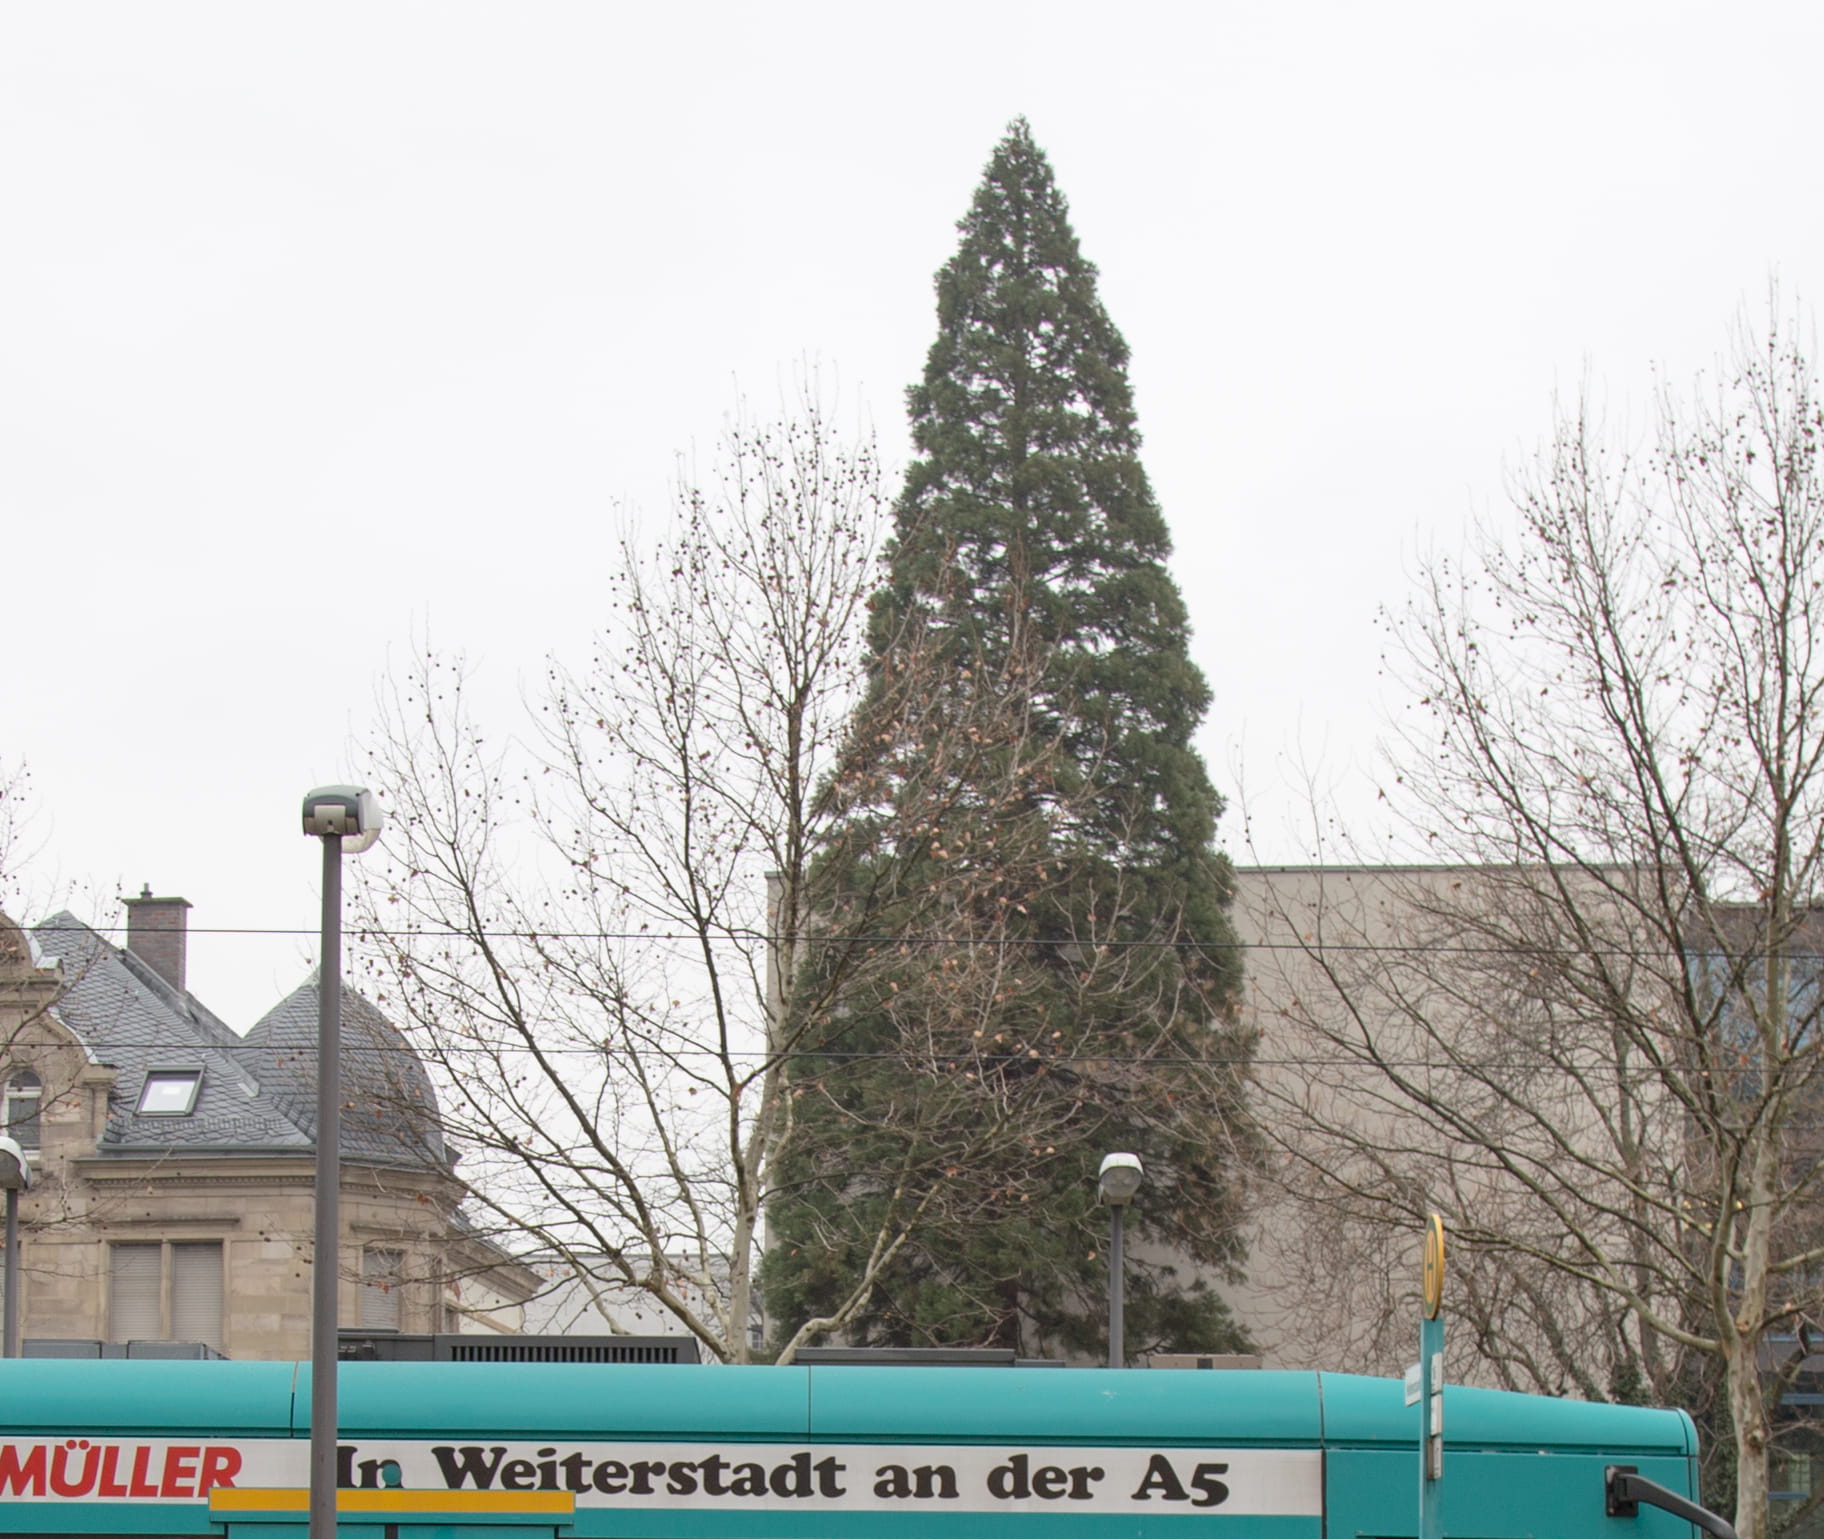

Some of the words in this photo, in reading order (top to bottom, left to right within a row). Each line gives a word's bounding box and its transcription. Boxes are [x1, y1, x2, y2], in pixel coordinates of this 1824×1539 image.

[335, 1446, 402, 1489] In
[430, 1445, 846, 1500] Weiterstadt
[875, 1460, 959, 1500] an
[987, 1453, 1105, 1501] der
[1130, 1453, 1230, 1507] A5
